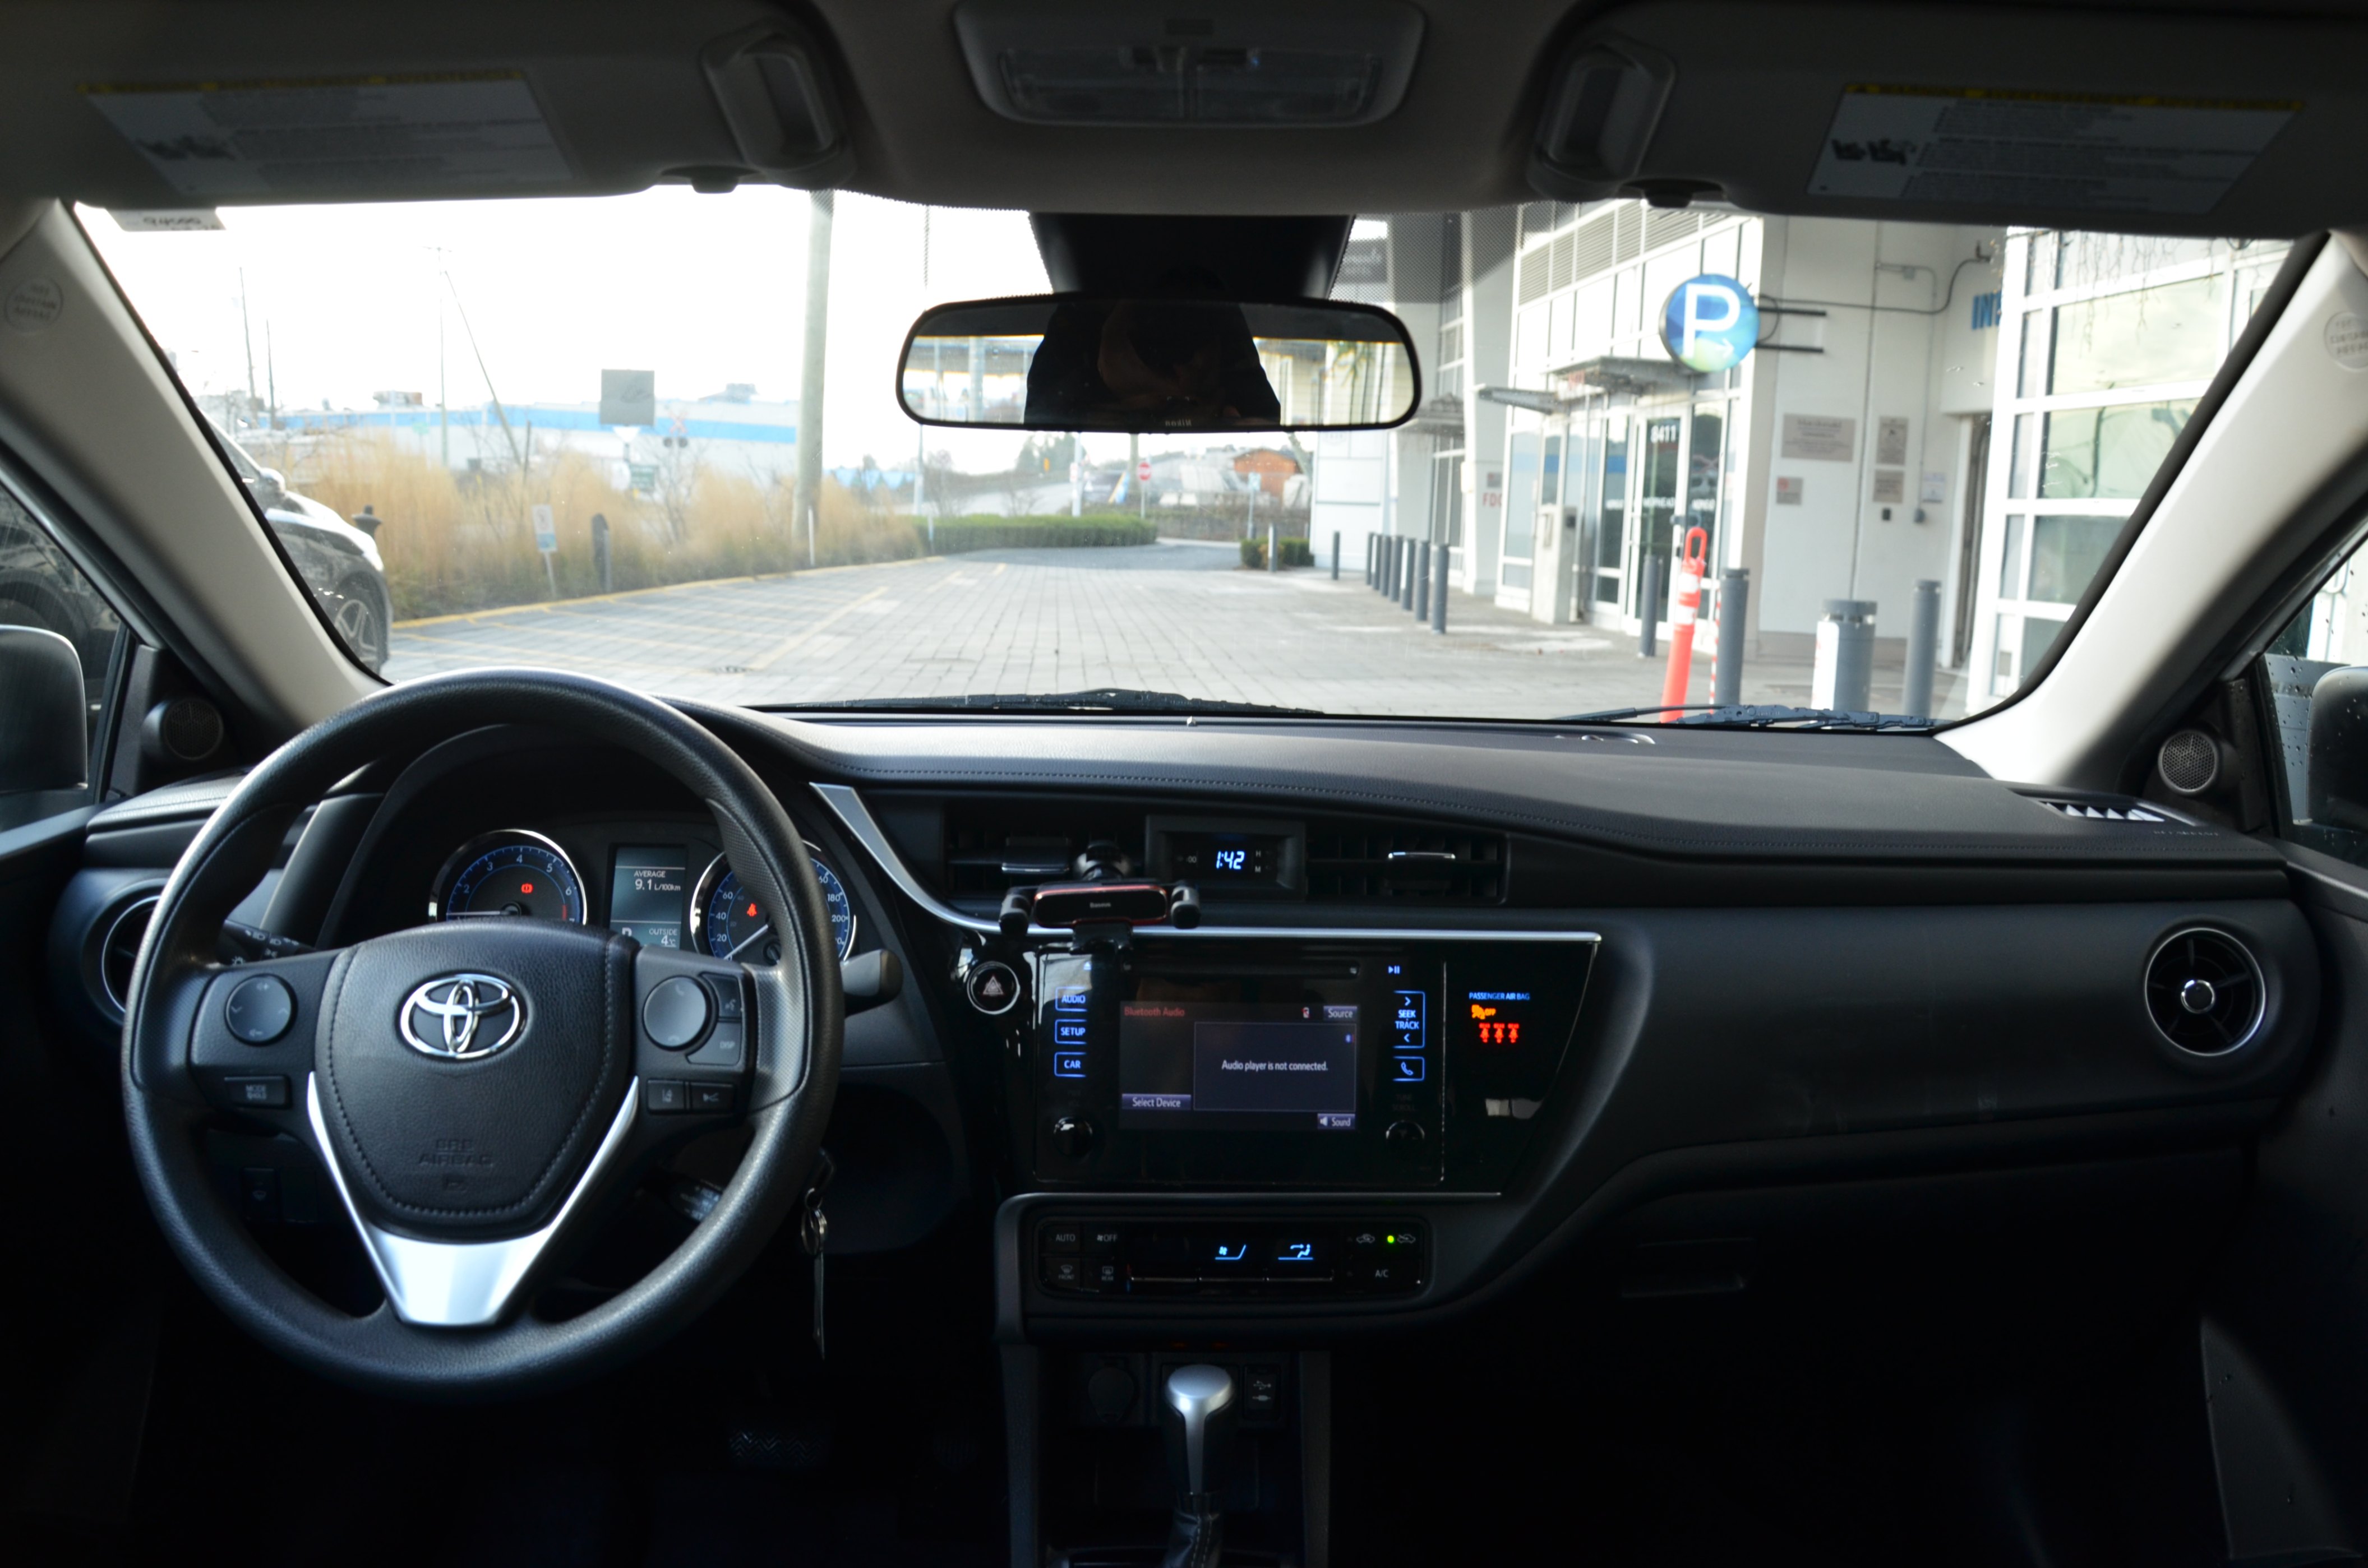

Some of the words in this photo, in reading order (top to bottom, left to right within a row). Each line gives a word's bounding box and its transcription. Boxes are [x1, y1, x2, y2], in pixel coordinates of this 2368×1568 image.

[1683, 283, 1741, 359] P
[1650, 424, 1677, 443] 8411
[516, 854, 523, 863] 4
[1215, 850, 1246, 870] 1:42
[486, 862, 493, 871] 3
[546, 863, 553, 873] 5
[635, 878, 652, 890] 9.1
[463, 884, 470, 894] 2
[565, 886, 573, 896] 6
[722, 891, 733, 900] 60
[827, 893, 841, 902] 180
[716, 912, 727, 921] 40
[832, 914, 846, 922] 200
[716, 933, 727, 942] 20
[1061, 995, 1086, 1004] AUDIO
[1124, 1007, 1161, 1017] Bluetooth
[1162, 1007, 1185, 1017] Audio
[1328, 1009, 1353, 1018] Source
[1398, 1009, 1416, 1018] SEEK
[1395, 1020, 1420, 1030] TRACK
[1060, 1026, 1086, 1036] SETUP
[1064, 1060, 1081, 1069] CAR
[1221, 1060, 1244, 1070] Audio
[1245, 1060, 1267, 1072] player
[1268, 1061, 1274, 1070] is
[1275, 1061, 1287, 1070] not
[1289, 1060, 1328, 1071] connected.
[1132, 1097, 1155, 1107] Select
[1156, 1097, 1181, 1108] Device
[1332, 1117, 1351, 1127] Sound
[1055, 1233, 1076, 1242] AUTO
[1375, 1269, 1390, 1278] A/C
